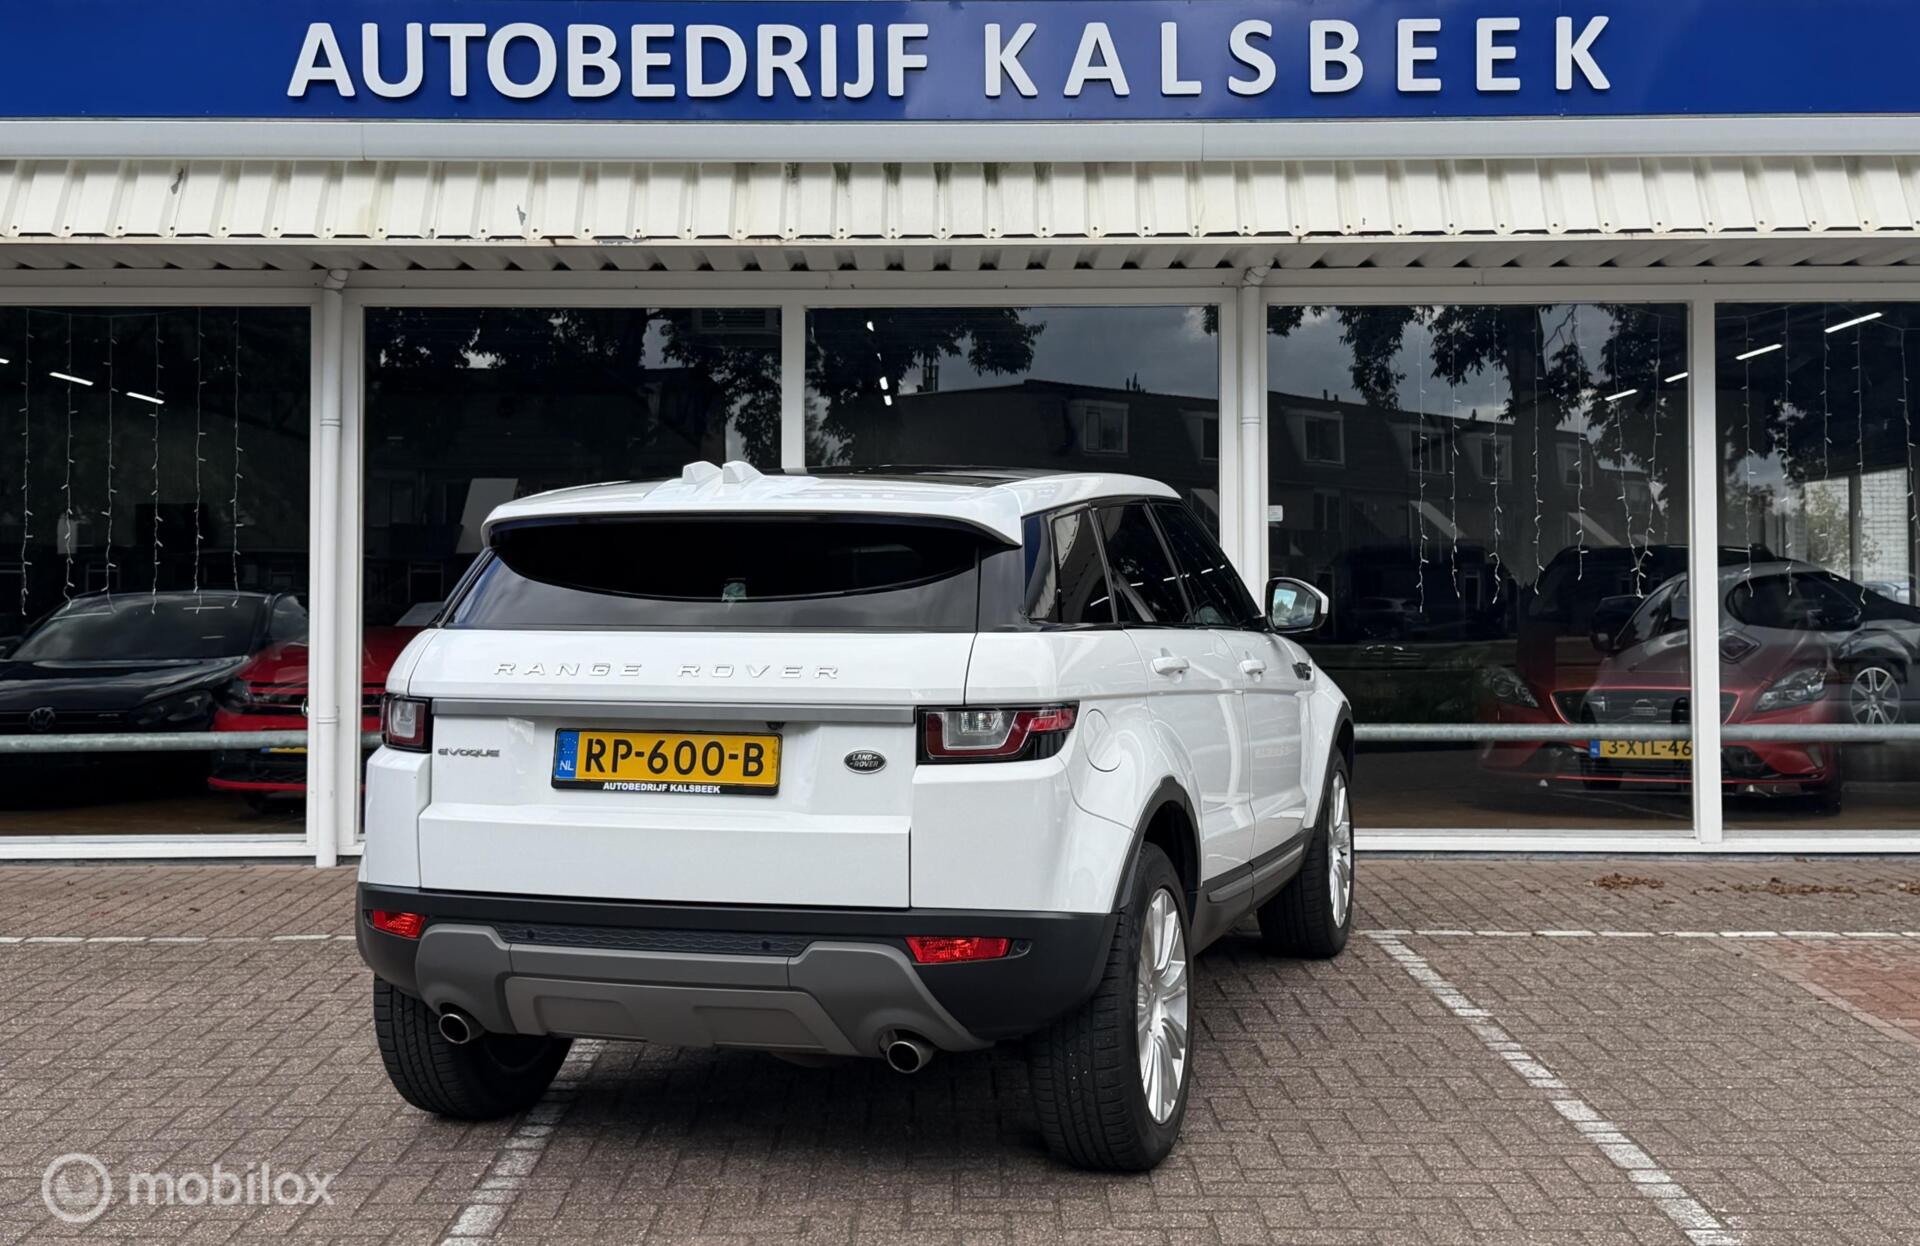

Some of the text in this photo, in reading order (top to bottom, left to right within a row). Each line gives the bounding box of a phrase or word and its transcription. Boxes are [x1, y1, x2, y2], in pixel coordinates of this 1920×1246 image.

[287, 15, 1612, 99] AUTOBEDRIJF KALSBEEK
[494, 663, 839, 679] RANGE ROVER
[438, 748, 501, 758] EVOQUE
[1608, 740, 1692, 756] 3-XTL-46
[559, 760, 574, 771] NL
[585, 738, 765, 777] RP-600-B
[603, 782, 721, 793] AUTOBEDRIJF KALSBEEK
